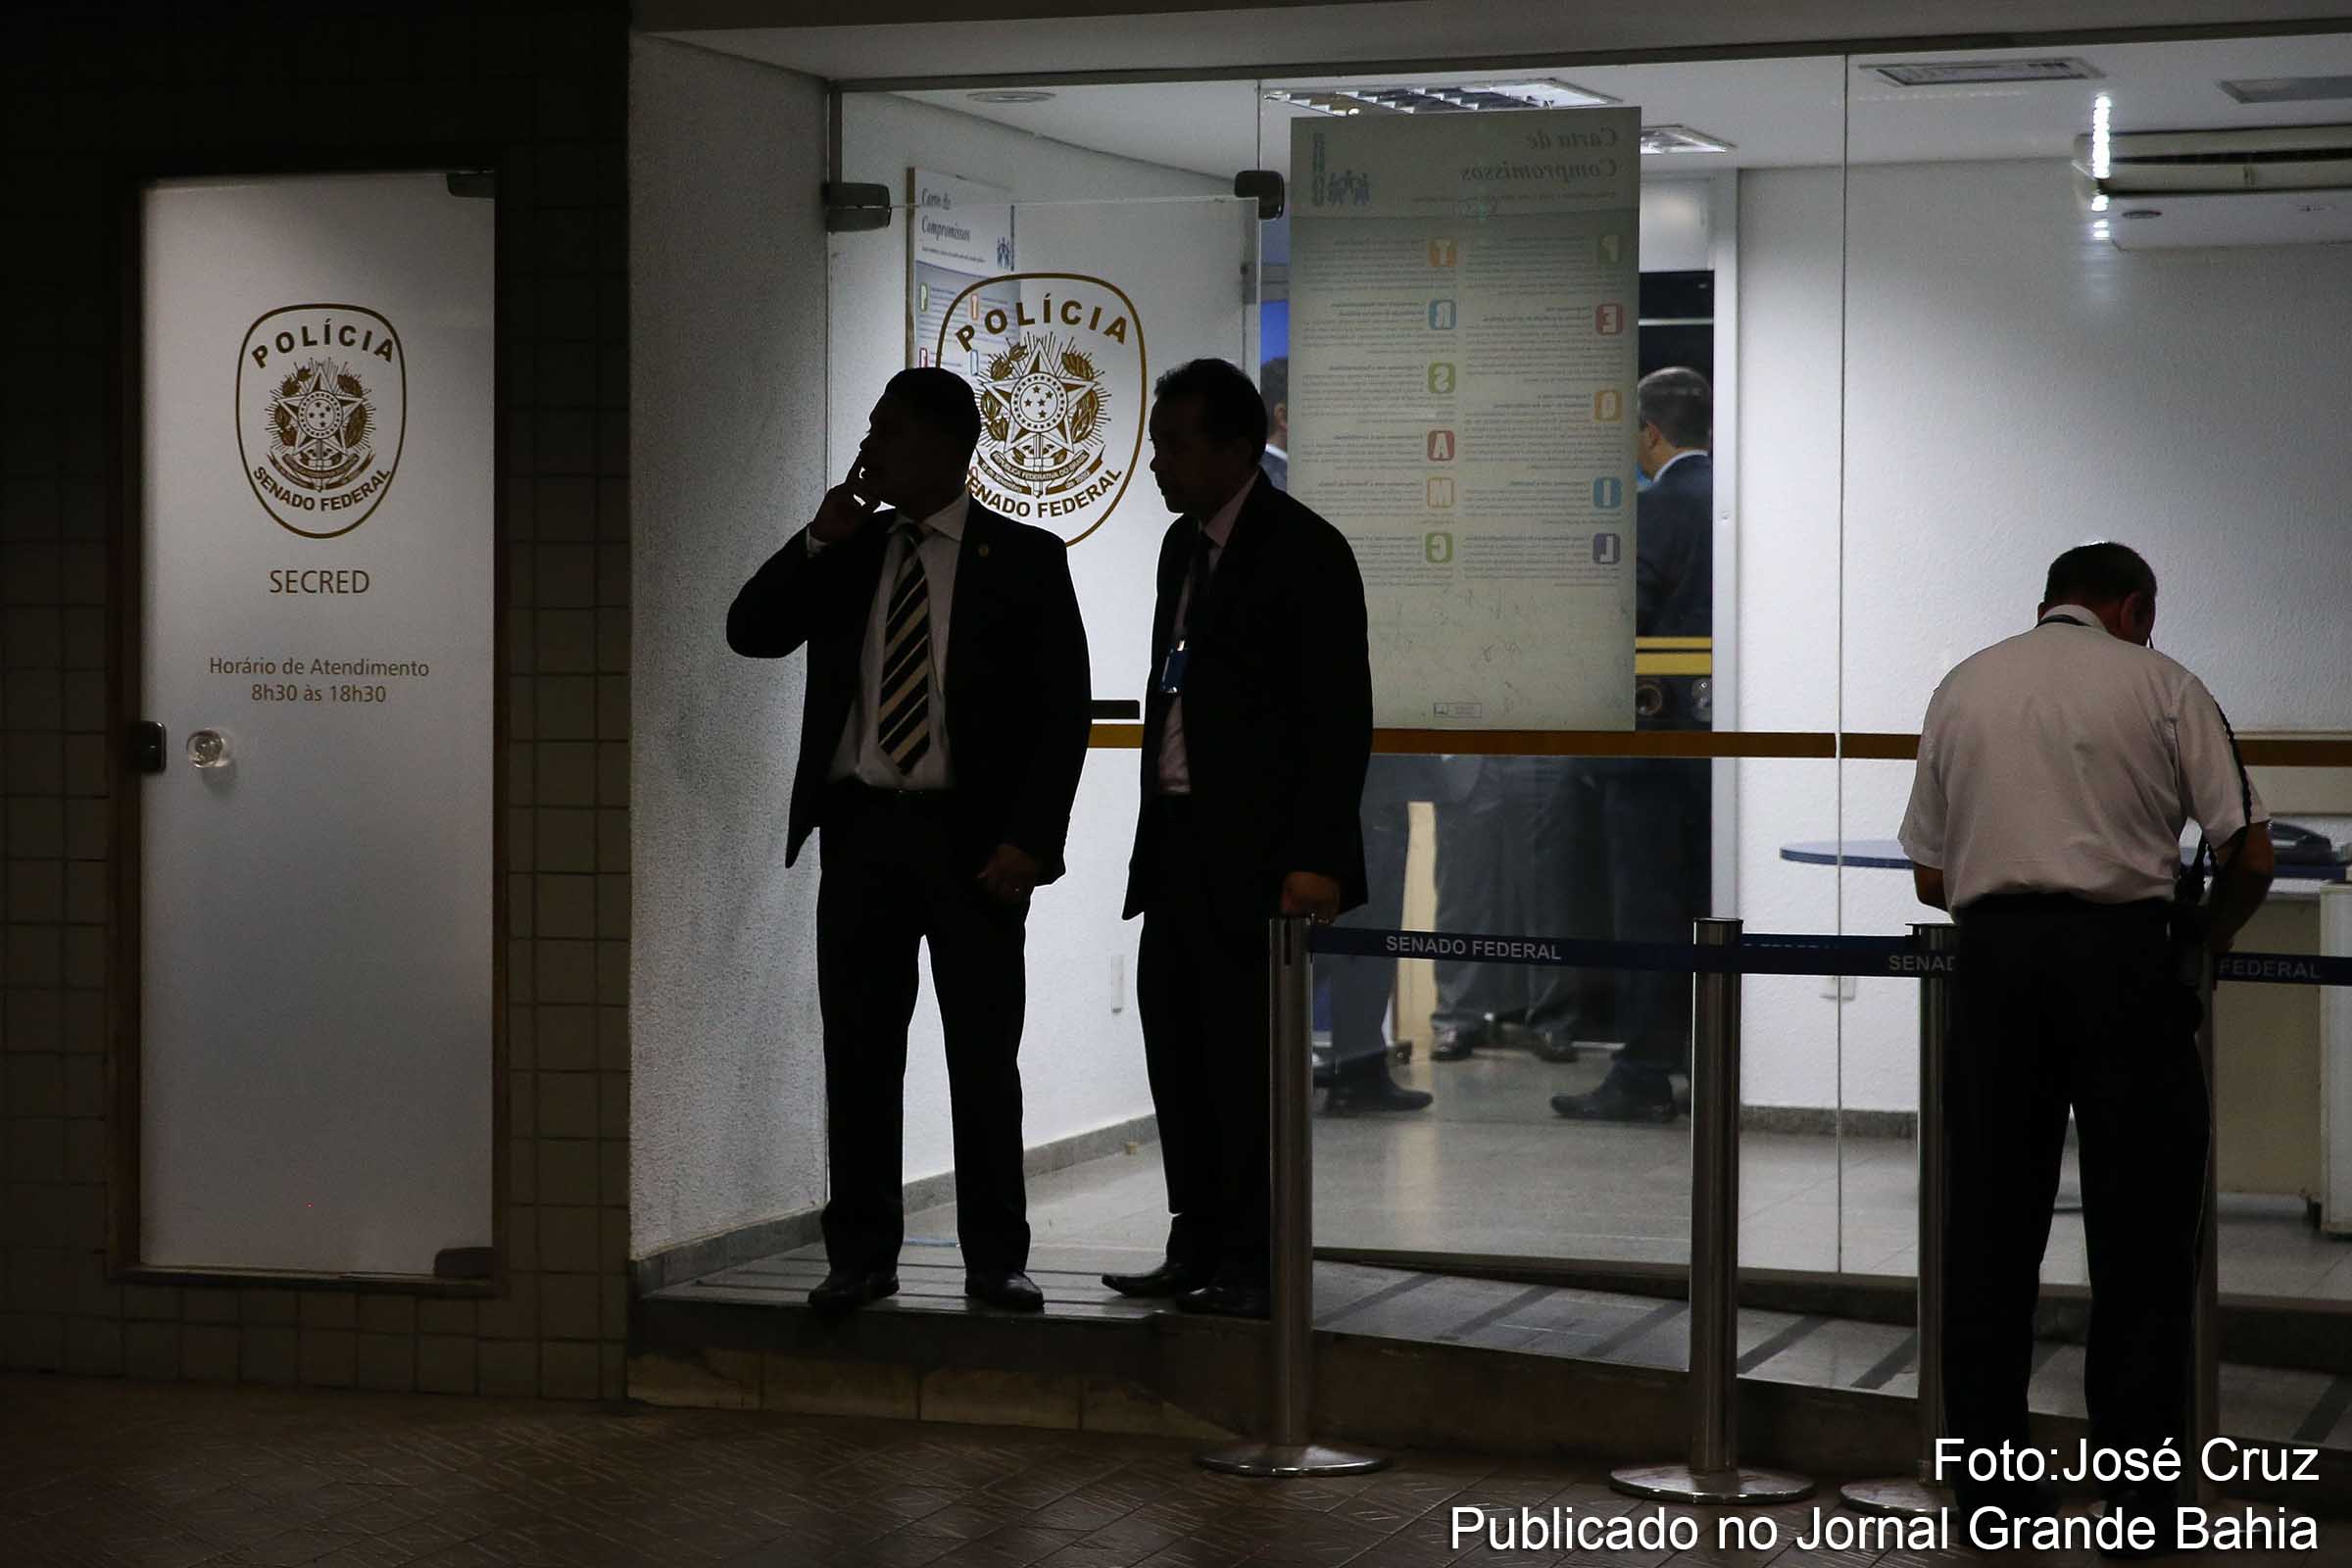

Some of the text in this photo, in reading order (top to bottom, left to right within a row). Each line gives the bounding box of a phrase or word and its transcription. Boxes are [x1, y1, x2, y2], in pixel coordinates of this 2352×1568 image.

[955, 293, 1128, 353] POLÍCIA
[252, 318, 393, 368] POLÍCIA
[253, 466, 315, 512] SENADO
[320, 468, 390, 512] FEDERAL
[965, 469, 1122, 518] ENADO FEDERAL
[270, 569, 369, 594] SECRED
[210, 656, 430, 677] Horário de Atendimento
[251, 683, 387, 703] 8h30 às 18h30
[1386, 935, 1562, 960] SENADO FEDERAL
[2219, 957, 2322, 979] FEDERAL
